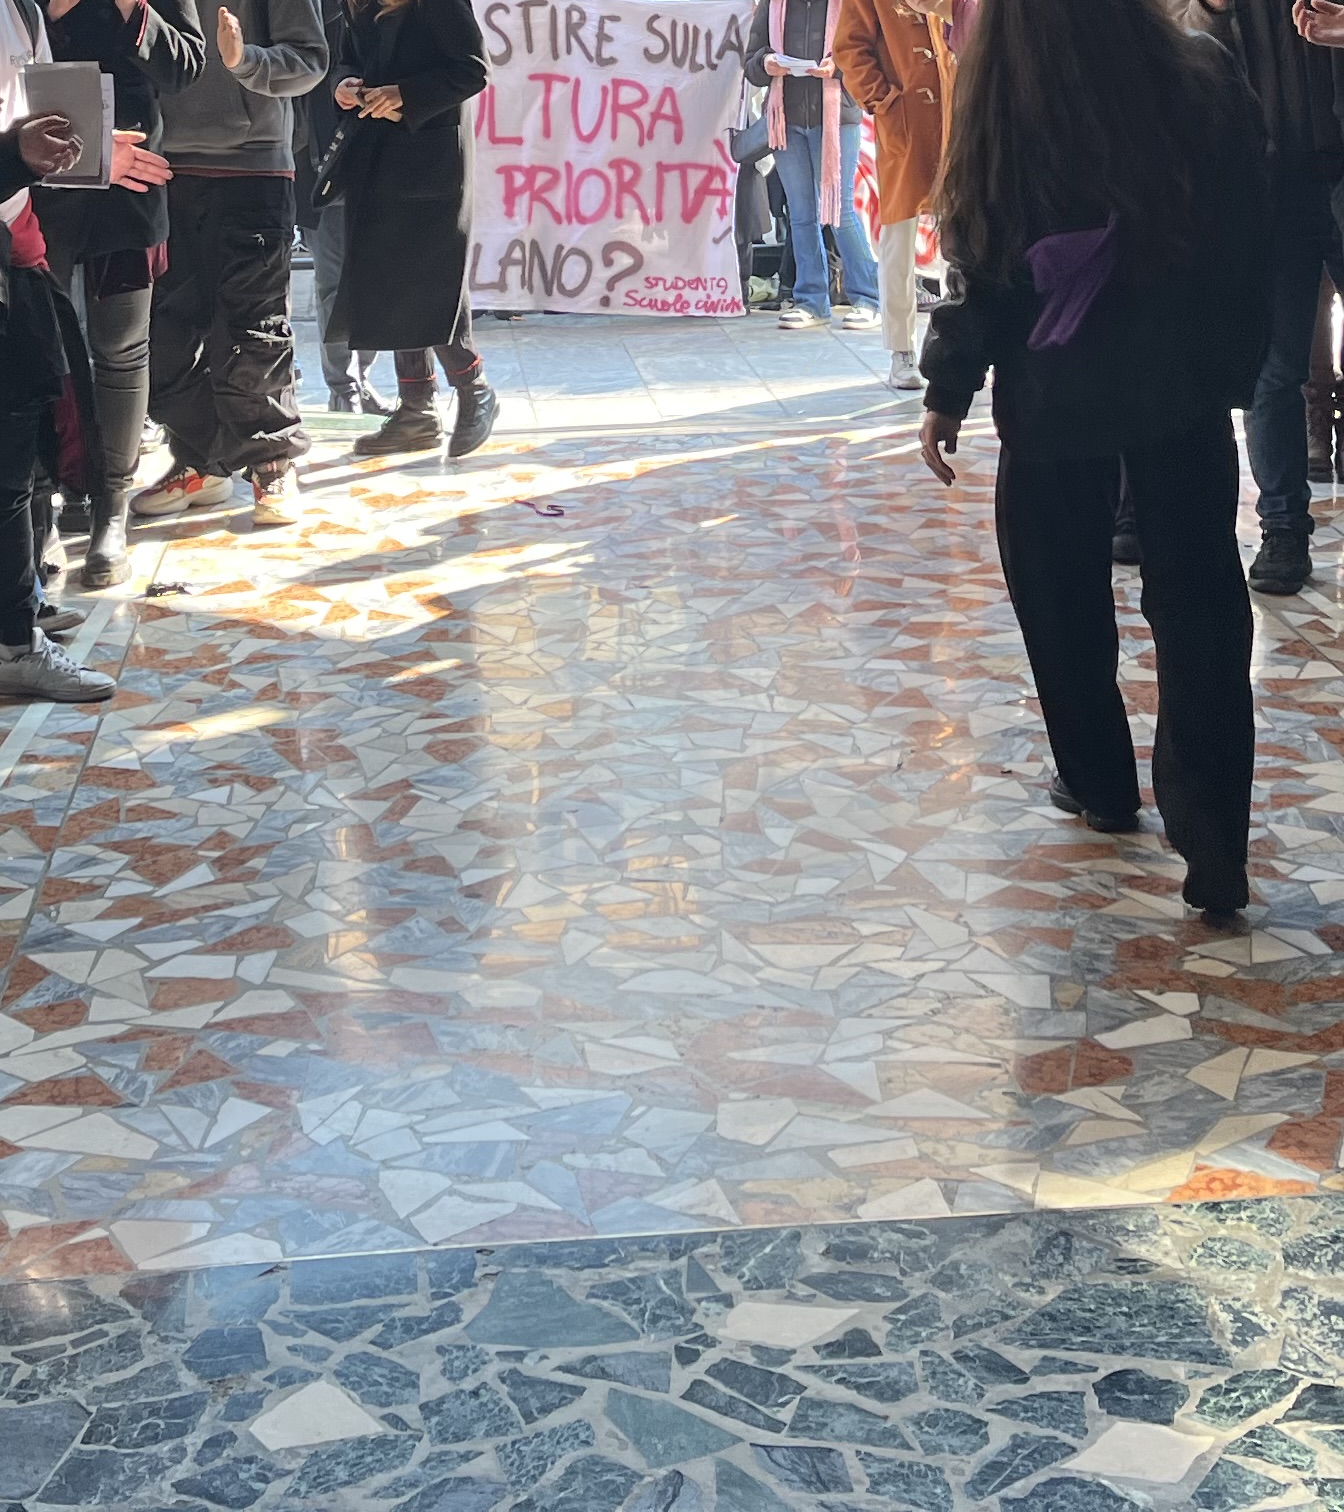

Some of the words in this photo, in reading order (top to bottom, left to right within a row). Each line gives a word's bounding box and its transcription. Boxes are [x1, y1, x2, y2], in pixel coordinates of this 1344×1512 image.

[643, 13, 746, 73] SULLA
[496, 139, 737, 226] PRIORITÀ
[623, 290, 691, 314] Scuole
